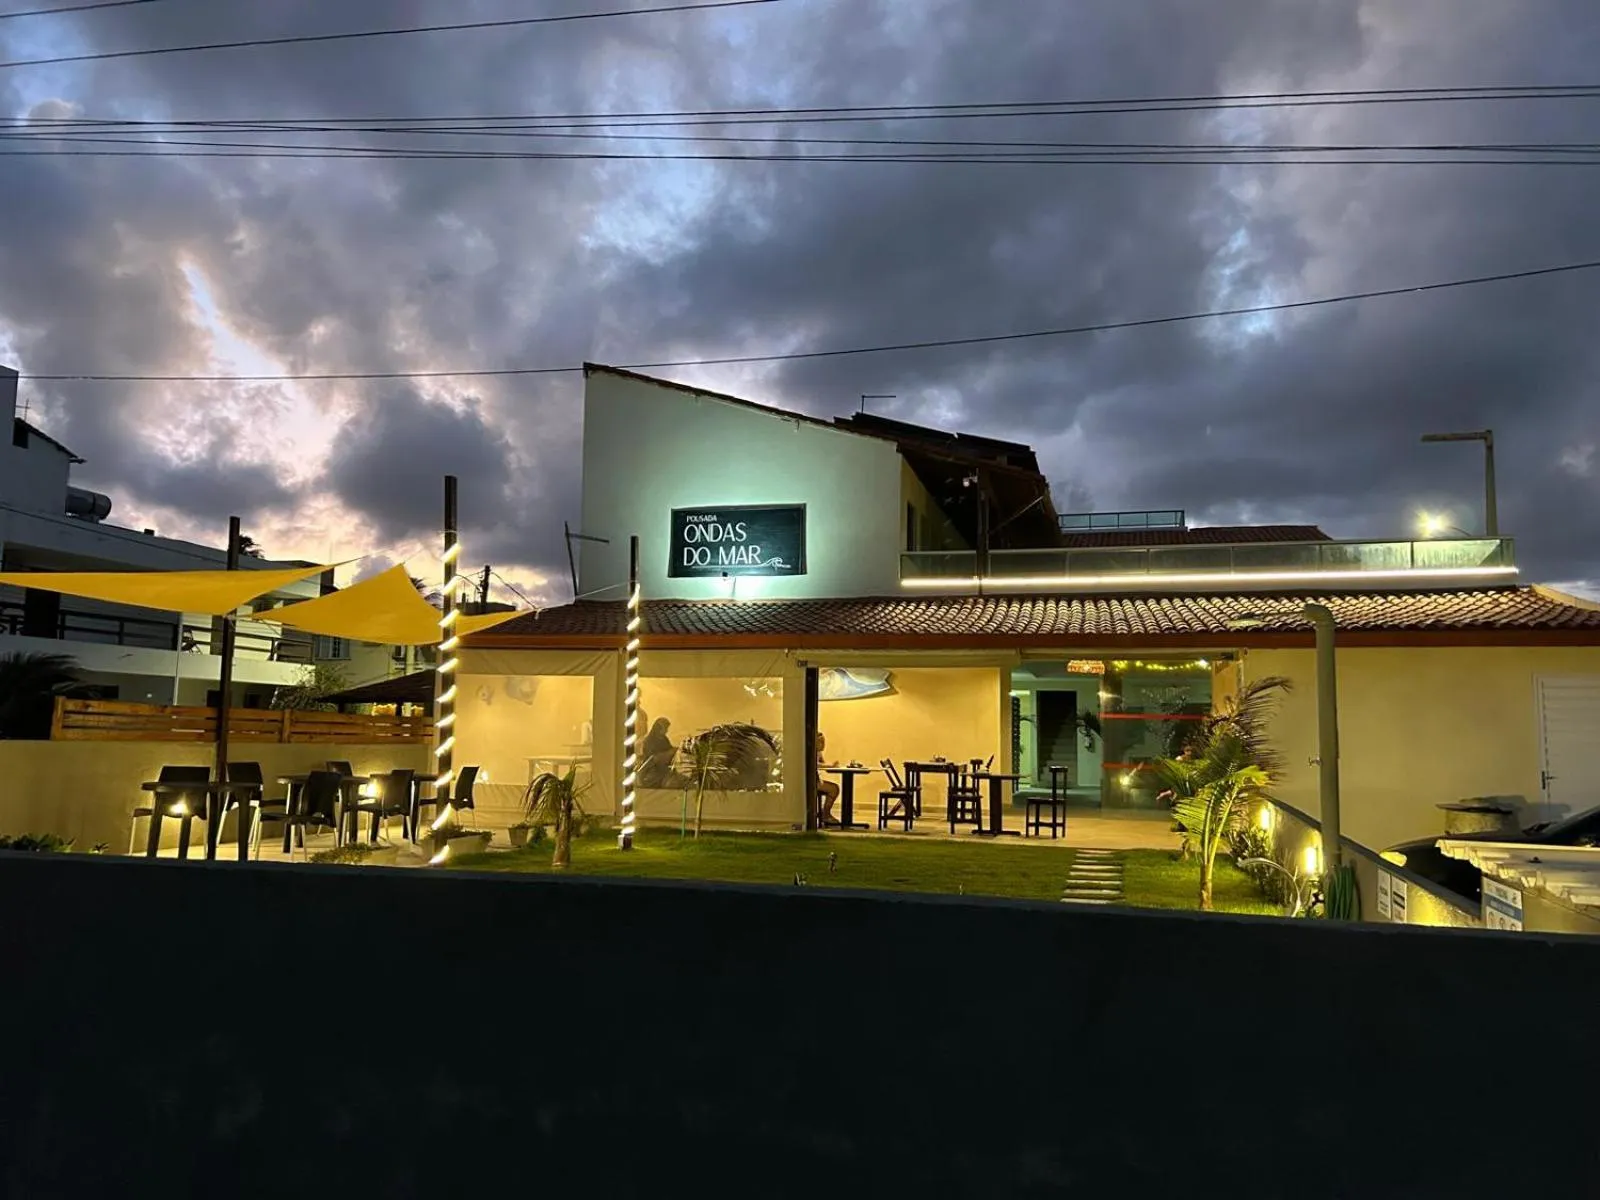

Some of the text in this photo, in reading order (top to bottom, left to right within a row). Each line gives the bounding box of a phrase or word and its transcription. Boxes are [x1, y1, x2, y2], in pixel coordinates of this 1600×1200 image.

[686, 514, 717, 523] POUSADA
[684, 522, 747, 543] ONDAS
[683, 545, 762, 566] DO MAR
